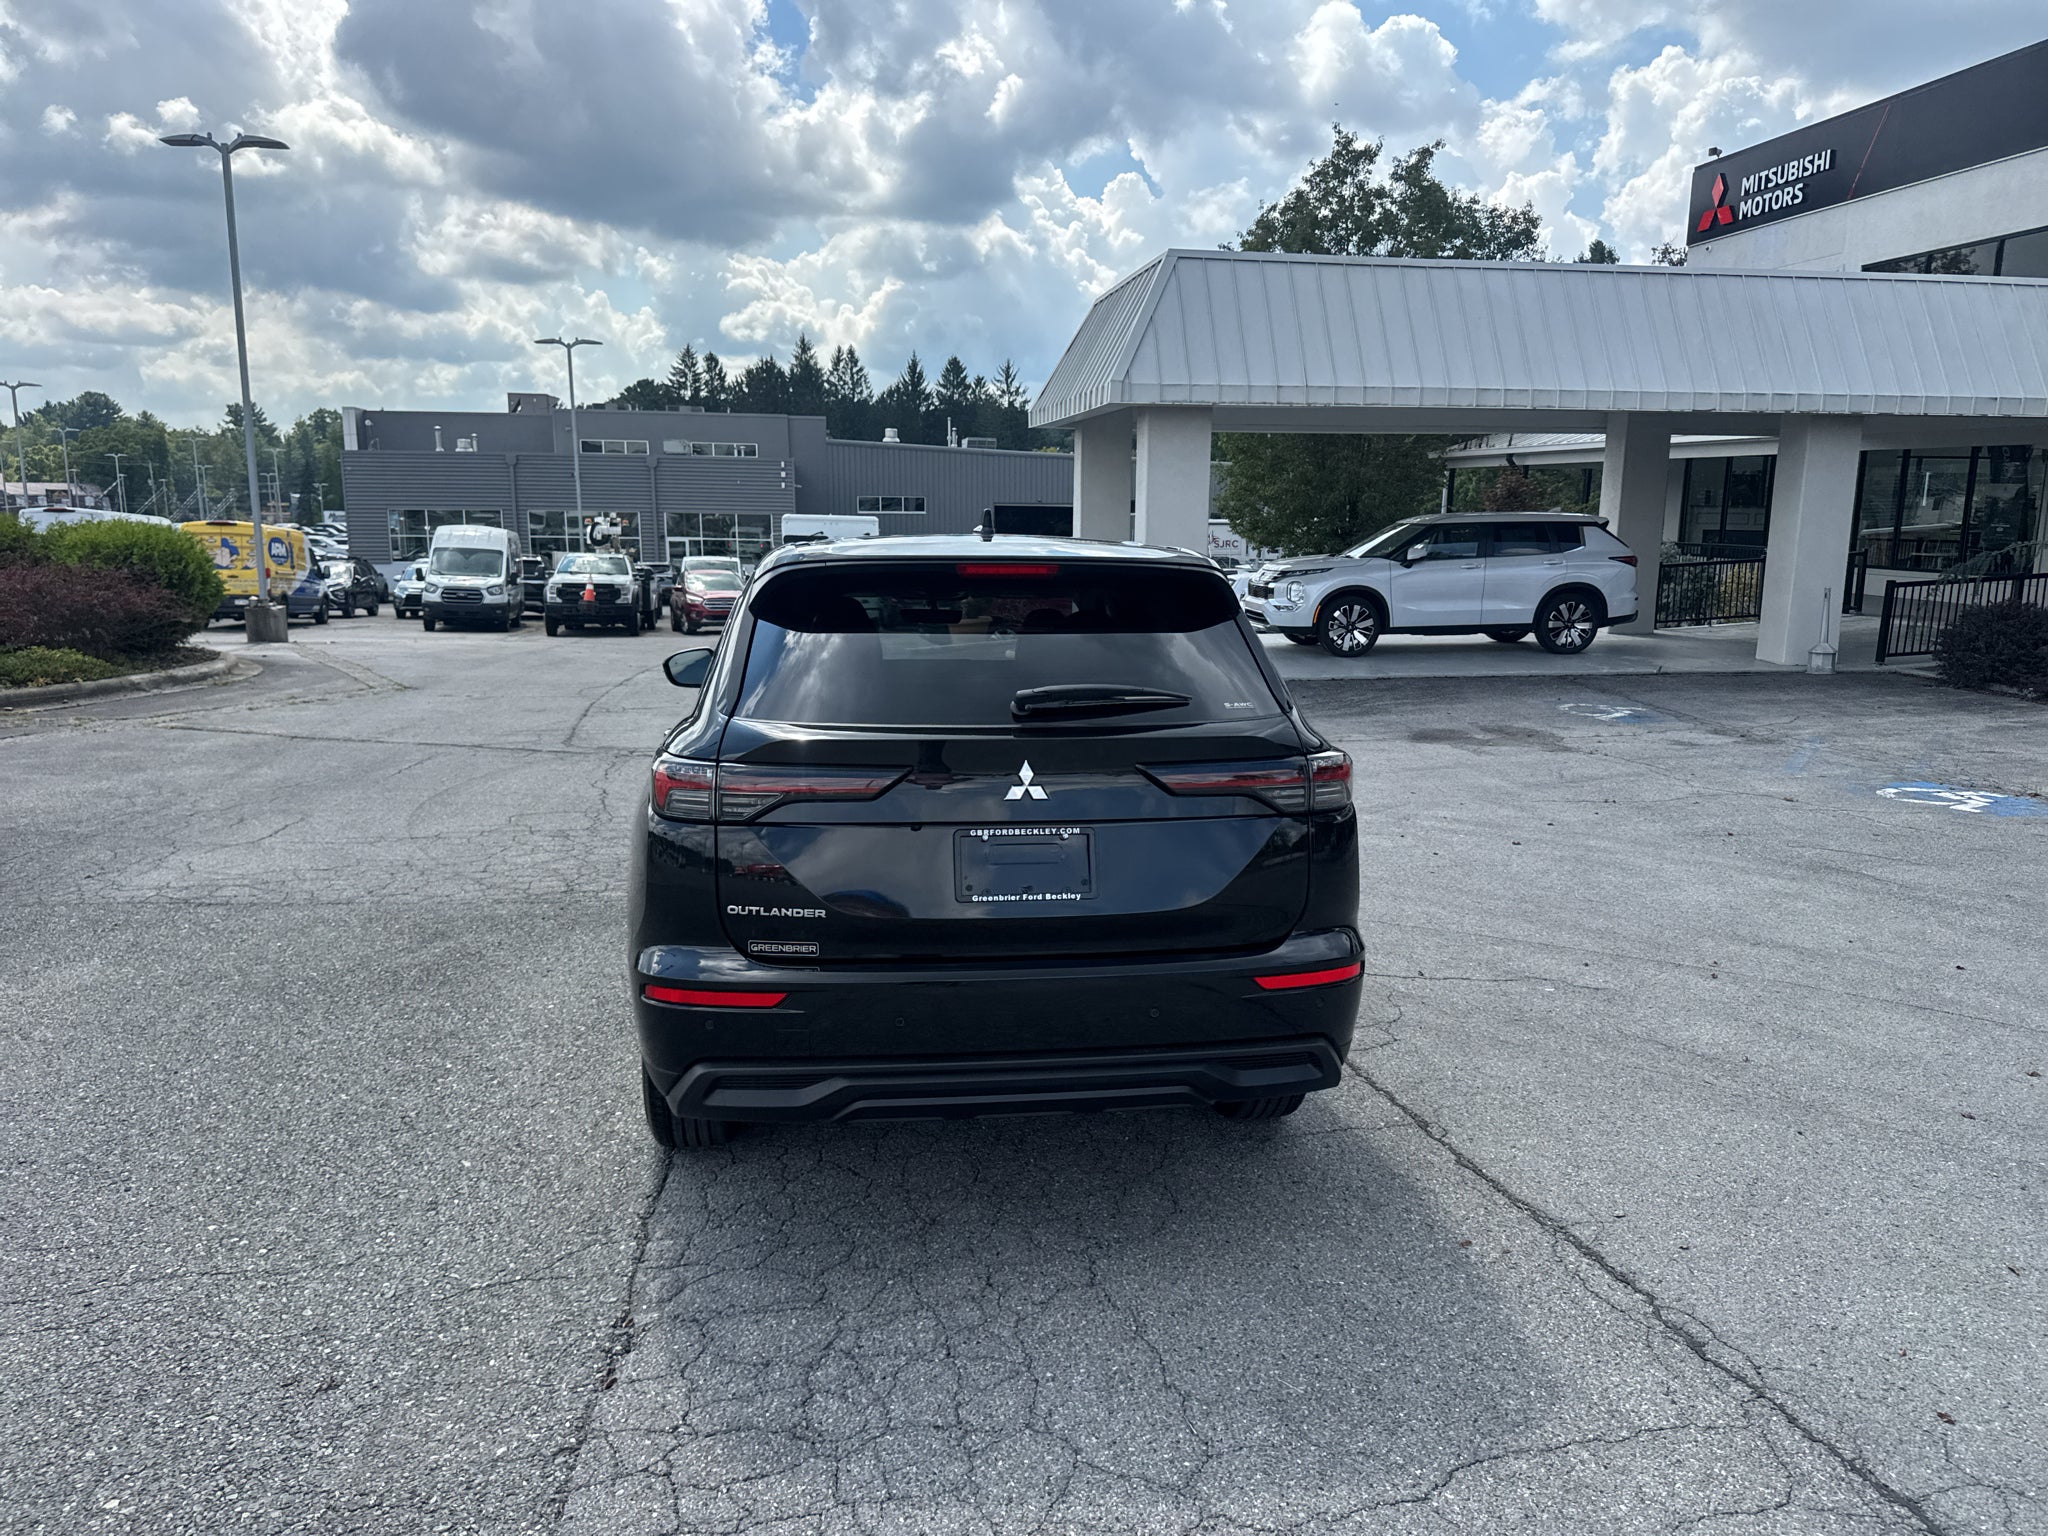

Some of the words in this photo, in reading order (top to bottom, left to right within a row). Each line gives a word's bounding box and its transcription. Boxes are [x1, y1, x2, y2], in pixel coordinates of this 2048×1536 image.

[1740, 149, 1832, 197] MITSUBISHI
[1738, 183, 1804, 221] MOTORS
[1213, 539, 1239, 548] SJRC
[970, 827, 1081, 836] GBRFORDBECKLEY.COM
[972, 894, 1020, 902] Greenbrier
[726, 905, 827, 918] OUTLANDER
[750, 943, 817, 953] GREENBRIER
